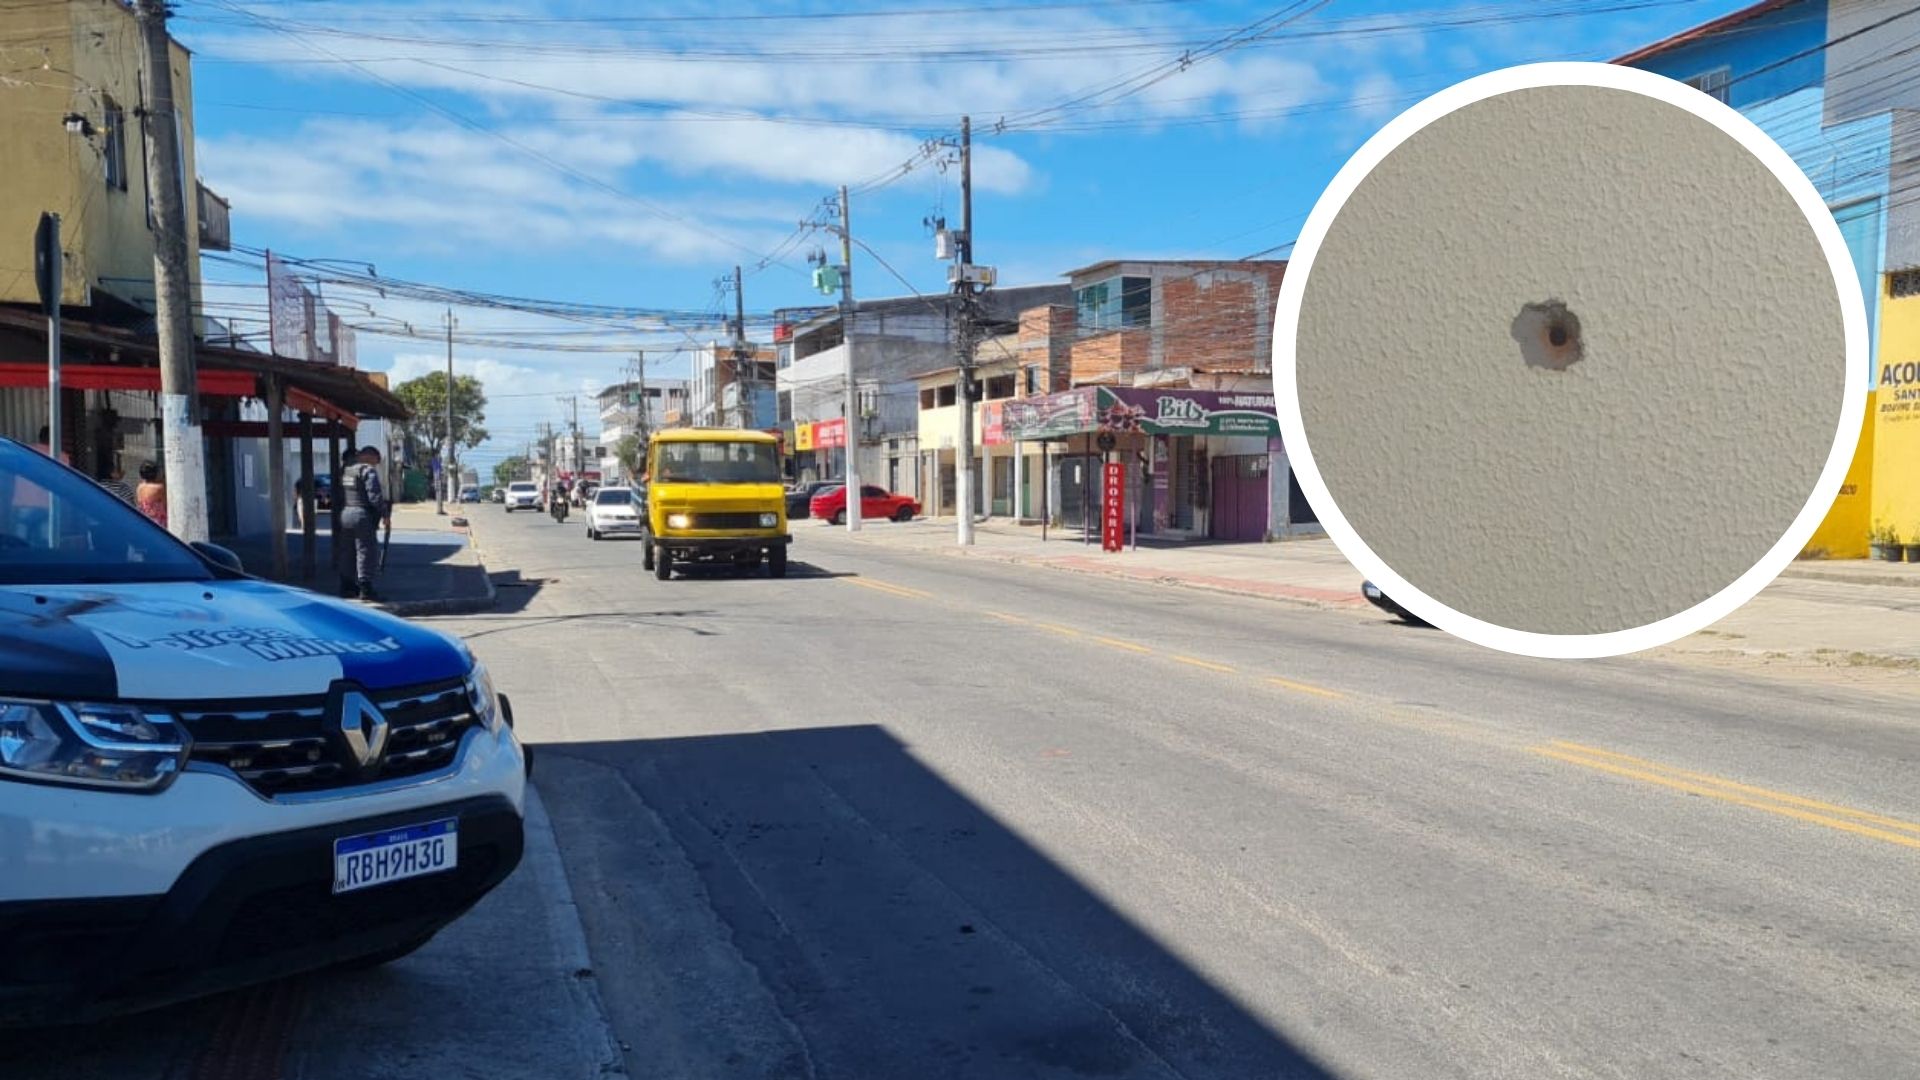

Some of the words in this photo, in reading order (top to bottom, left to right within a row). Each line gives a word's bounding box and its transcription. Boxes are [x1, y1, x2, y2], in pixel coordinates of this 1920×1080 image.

[1108, 465, 1119, 548] DROGARIA
[241, 636, 402, 661] Militar
[347, 838, 445, 886] RBH9H30
